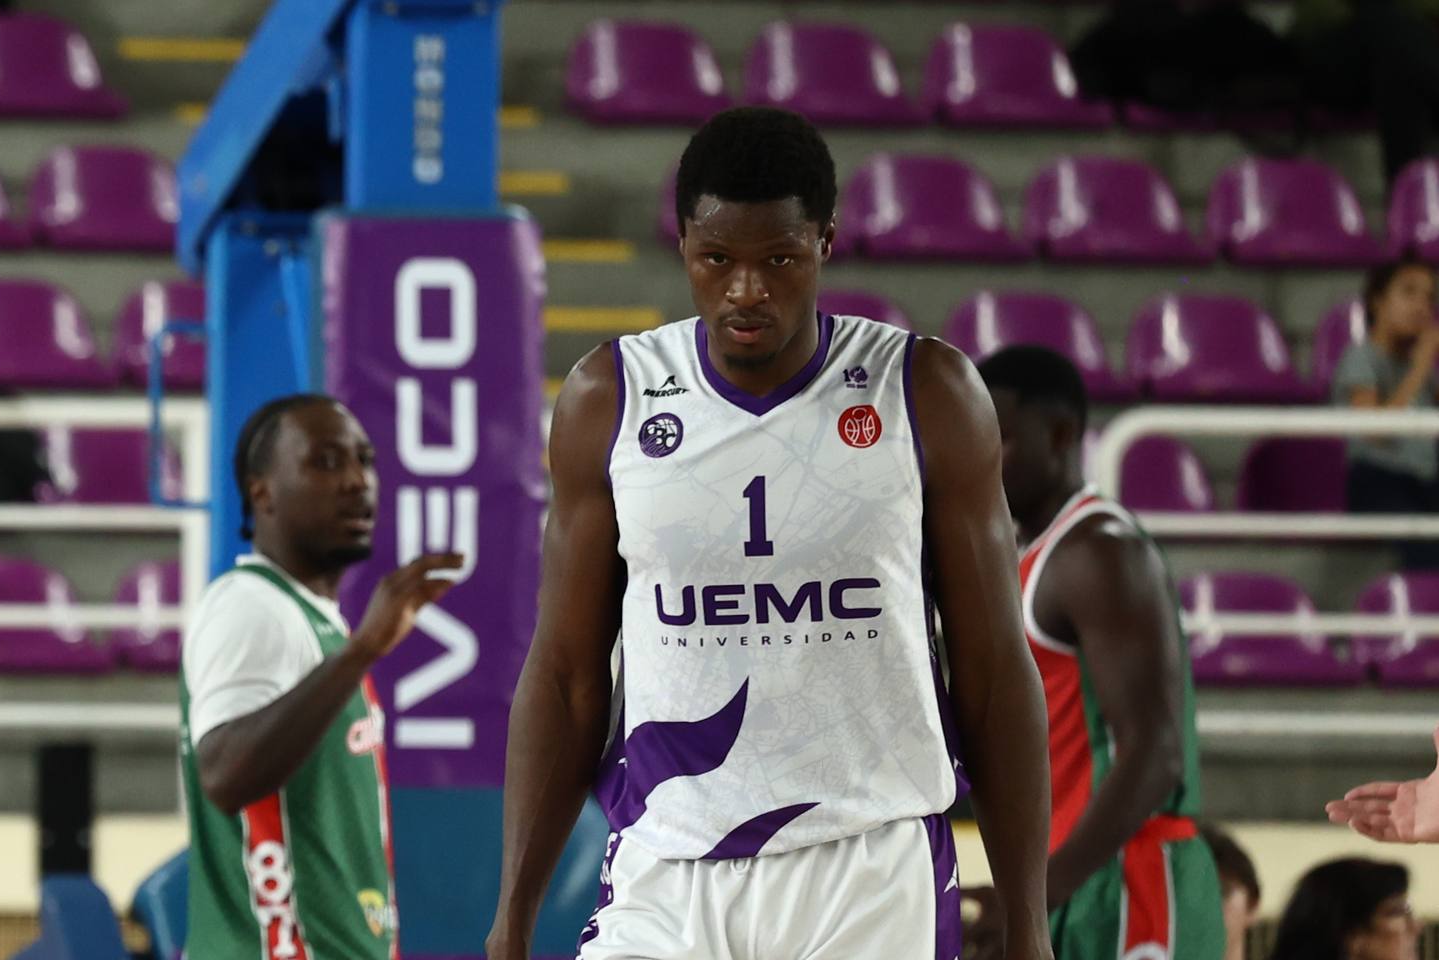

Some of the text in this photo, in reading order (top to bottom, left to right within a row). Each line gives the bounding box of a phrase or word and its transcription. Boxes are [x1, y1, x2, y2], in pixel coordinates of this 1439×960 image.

[394, 257, 479, 748] IVECO
[743, 475, 774, 557] 1
[655, 578, 882, 626] UEMC
[661, 629, 878, 647] UNIVERSIDAD
